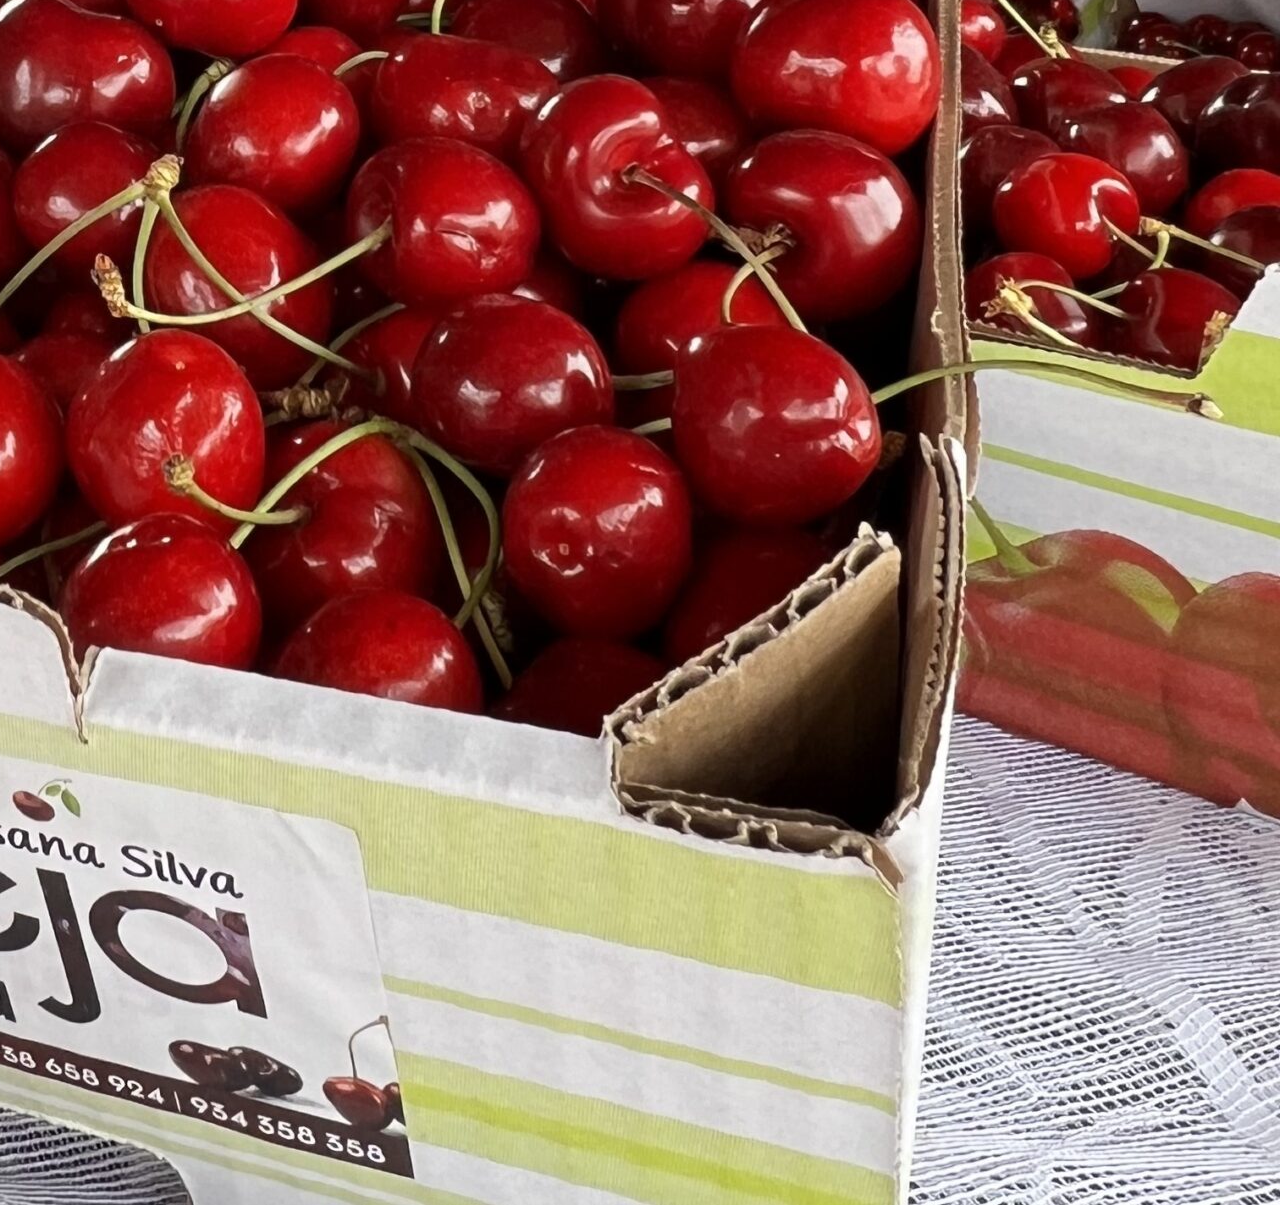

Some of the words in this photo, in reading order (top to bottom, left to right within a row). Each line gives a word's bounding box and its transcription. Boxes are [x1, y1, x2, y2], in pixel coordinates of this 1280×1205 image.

[120, 844, 244, 899] Silva
[45, 1057, 100, 1087] 658
[107, 1073, 165, 1105] 924
[190, 1096, 249, 1129] 934
[257, 1114, 317, 1146] 358
[325, 1131, 386, 1165] 358
